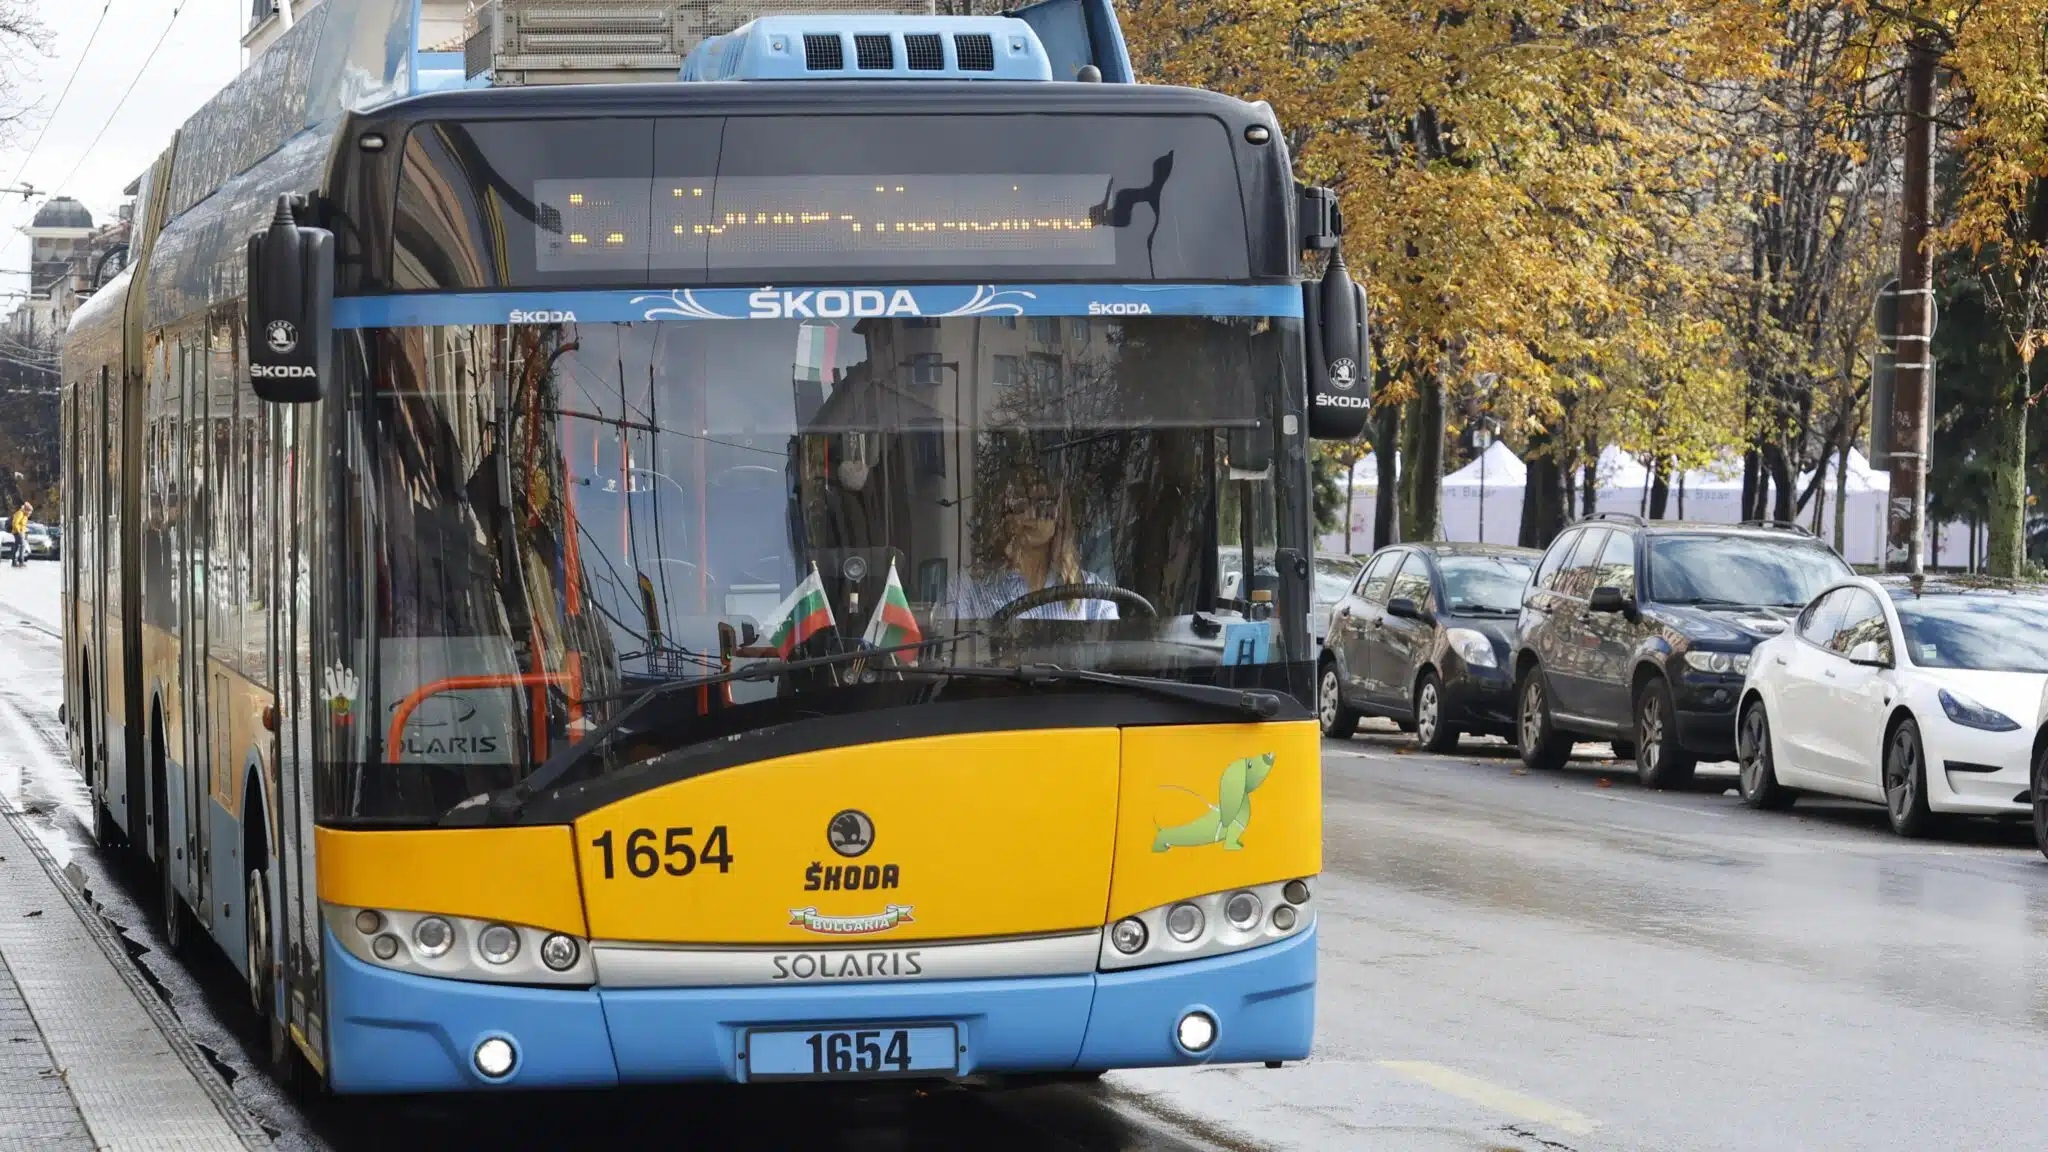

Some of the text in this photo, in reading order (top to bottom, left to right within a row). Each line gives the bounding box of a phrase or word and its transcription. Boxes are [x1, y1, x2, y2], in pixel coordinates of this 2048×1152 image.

[749, 286, 921, 318] ŠKODA
[1088, 301, 1152, 315] ŠKODA
[509, 308, 577, 324] ŠKODA
[249, 363, 317, 378] ŠKODA
[1315, 392, 1371, 409] ŠKODA
[591, 826, 734, 880] 1654
[803, 861, 900, 891] ŠKODA
[812, 918, 891, 932] BULGARIA
[772, 951, 922, 979] SOLARIS
[806, 1030, 911, 1074] 1654
